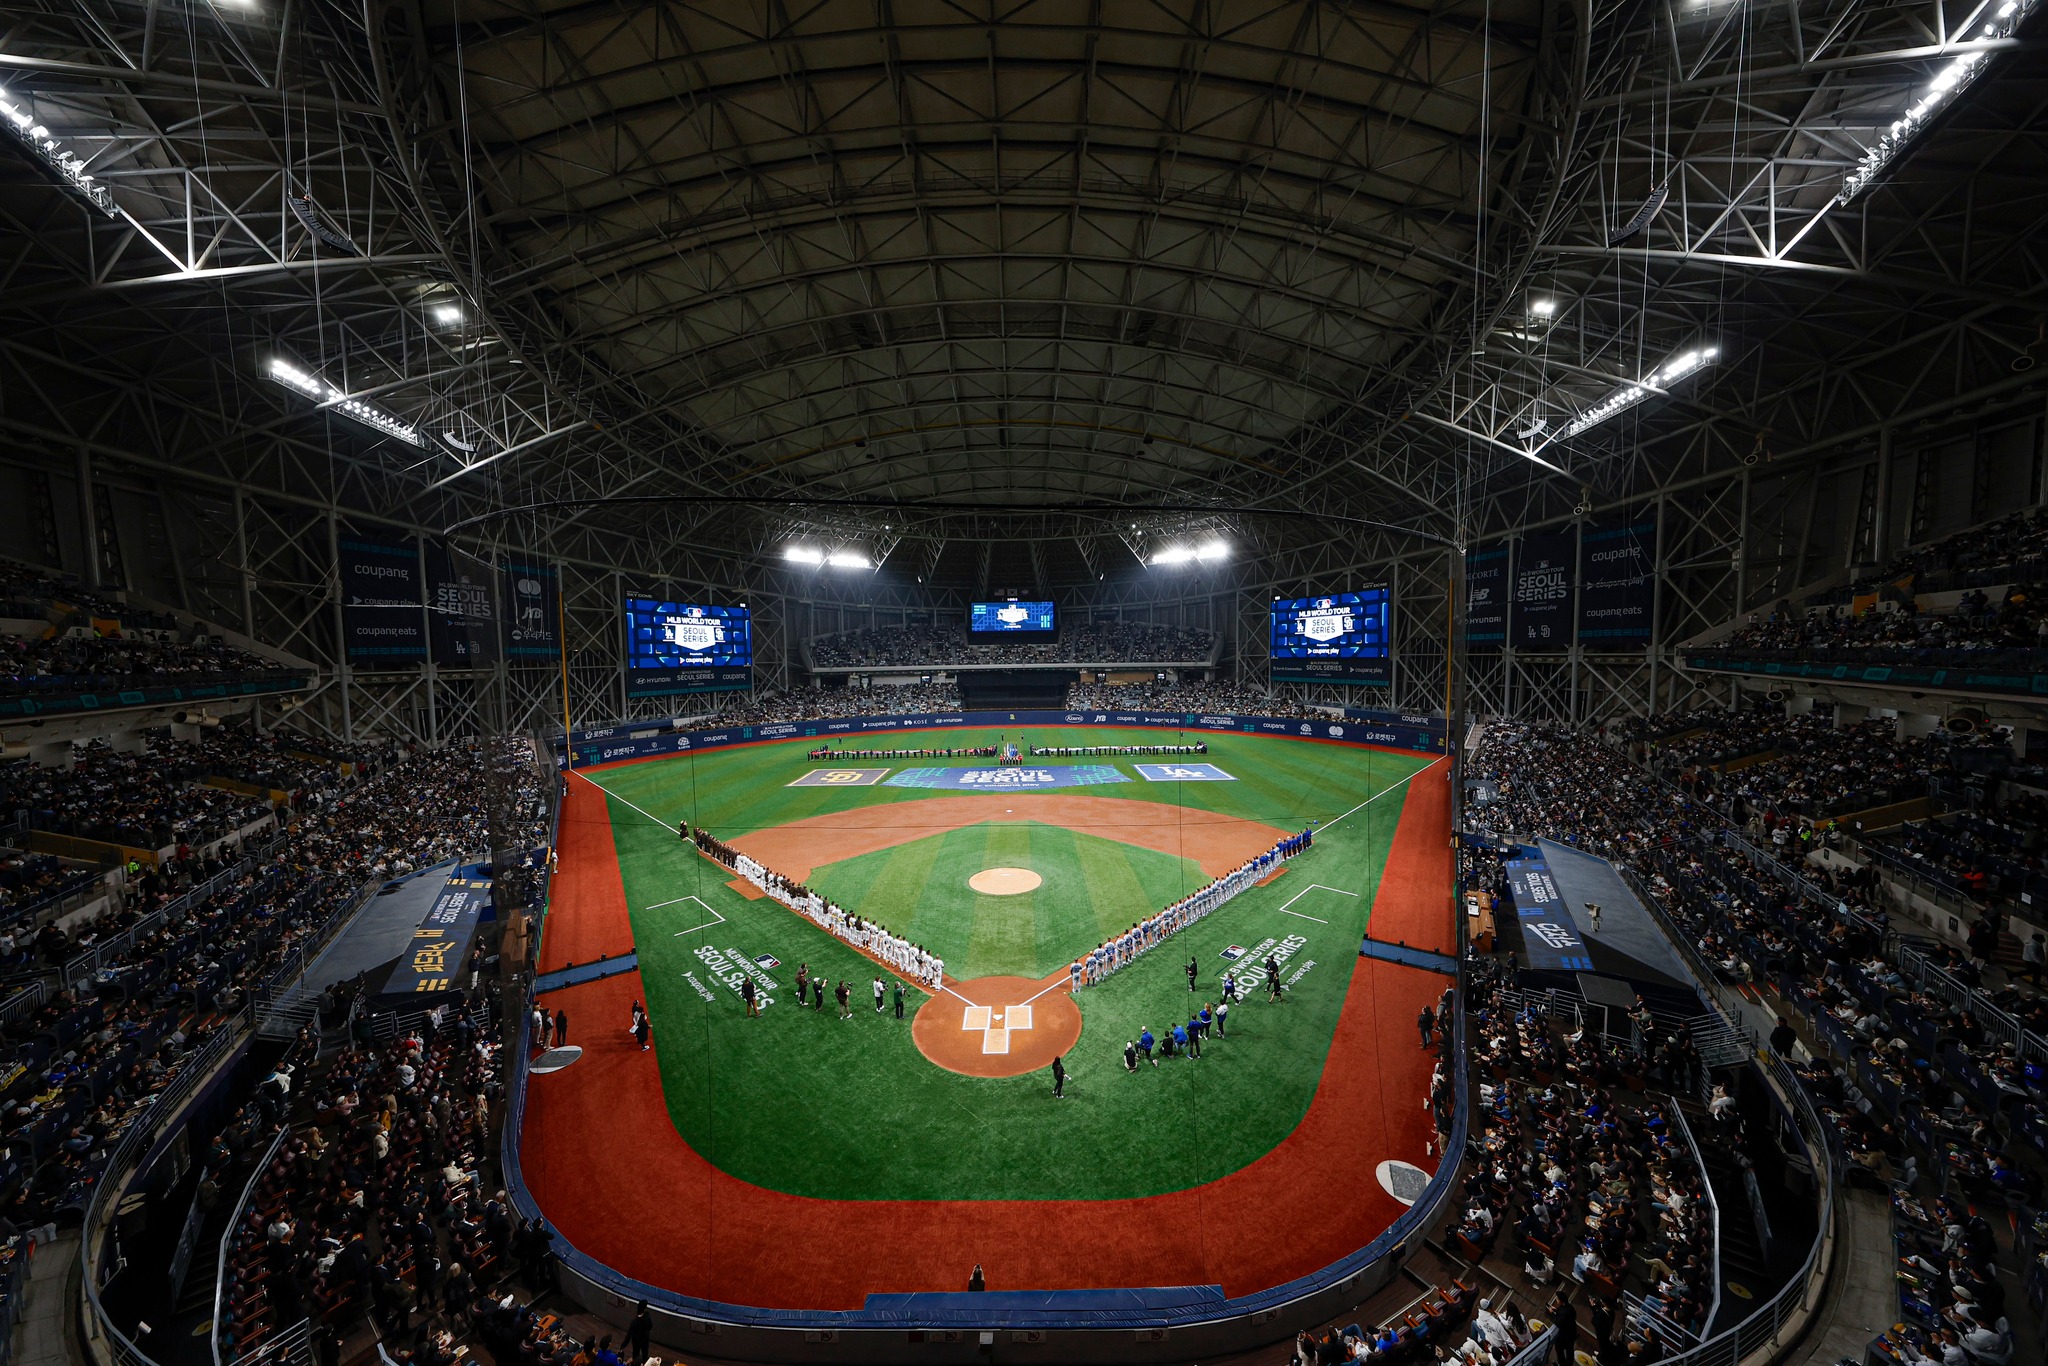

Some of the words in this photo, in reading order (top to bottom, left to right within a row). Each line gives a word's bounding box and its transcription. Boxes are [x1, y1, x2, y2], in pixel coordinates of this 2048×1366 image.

[1591, 546, 1641, 562] coupang
[354, 564, 409, 581] coupang
[1530, 568, 1550, 576] WORLD
[1518, 572, 1567, 589] SEOUL
[437, 588, 489, 604] SEOUL
[1517, 585, 1567, 602] SERIES
[436, 601, 491, 617] SERIES
[522, 606, 543, 620] JTB
[1299, 610, 1312, 618] MLB
[1312, 608, 1333, 616] WORLD
[1333, 607, 1351, 615] TOUR
[1586, 608, 1622, 618] coupang
[1622, 606, 1643, 615] eats
[666, 616, 681, 624] MLB
[681, 616, 705, 625] WORLD
[705, 618, 721, 626] TOUR
[1312, 618, 1335, 626] SEOUL
[1469, 616, 1502, 625] HYUNDAI
[357, 626, 398, 637] coupang
[398, 626, 418, 636] eats
[683, 627, 707, 635] SEOUL
[1311, 626, 1336, 634] SERIES
[1527, 625, 1536, 638] LA
[1540, 625, 1551, 638] SD
[683, 635, 709, 643] SERIES
[455, 640, 466, 654] LA
[722, 673, 746, 681] coupang
[1094, 714, 1107, 722] JTB
[1117, 715, 1137, 723] coupang
[1217, 718, 1235, 726] SERIES
[1401, 715, 1429, 726] coupang
[868, 721, 887, 729] coupang
[887, 720, 897, 728] play
[1263, 722, 1286, 730] coupang
[593, 728, 614, 738] 로켓직구
[703, 734, 728, 743] coupang
[1375, 732, 1396, 743] 로켓직구
[612, 746, 635, 756] 로켓직구
[821, 771, 864, 783] SD
[1157, 766, 1207, 778] LA
[1526, 872, 1543, 888] SEOUL
[1532, 885, 1549, 903] SERIES
[449, 892, 468, 908] SERIES
[440, 907, 460, 923] SEOUL
[1236, 950, 1263, 970] WORLD
[1255, 938, 1277, 954] TOUR
[693, 945, 735, 977] SEOUL
[723, 947, 738, 959] MLB
[734, 956, 758, 977] WORLD
[755, 970, 778, 991] TOUR
